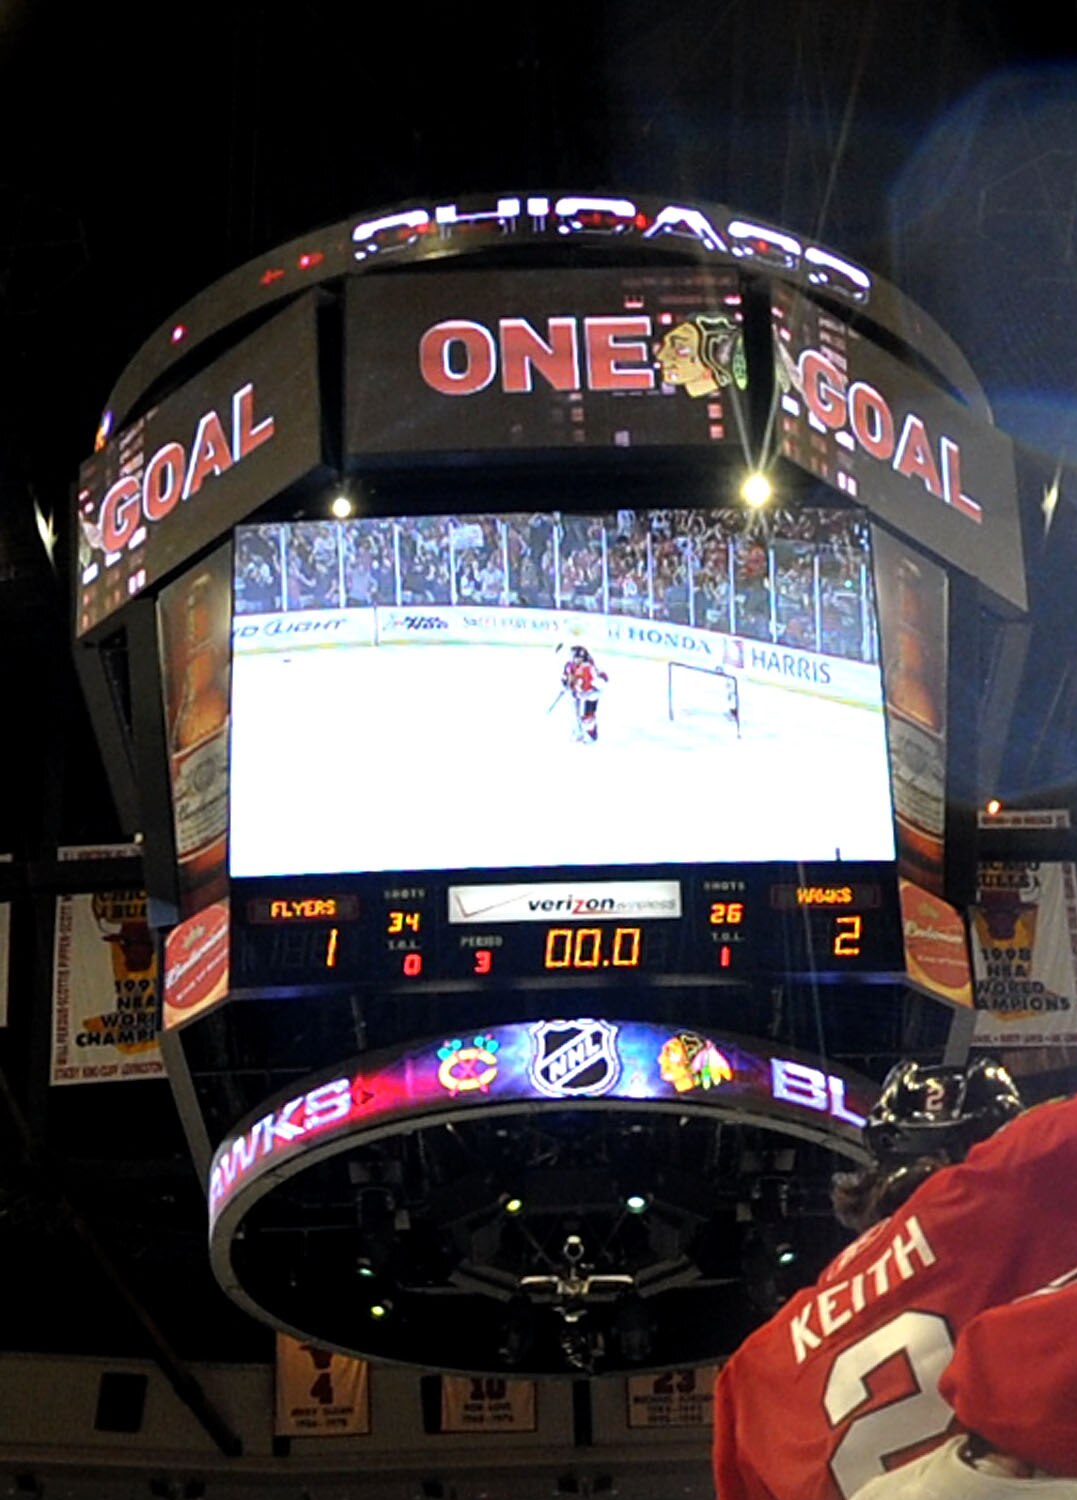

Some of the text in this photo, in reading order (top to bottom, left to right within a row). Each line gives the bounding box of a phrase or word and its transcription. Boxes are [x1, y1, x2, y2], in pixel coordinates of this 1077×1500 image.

[418, 316, 655, 396] ONE
[799, 348, 983, 523] GOAL
[100, 382, 275, 554] GOAL
[627, 625, 713, 656] HONDA
[750, 648, 832, 684] HARRIS
[270, 899, 337, 919] FLYERS
[528, 894, 615, 915] verizon
[709, 903, 743, 924] 26
[388, 912, 421, 934] 34
[833, 915, 862, 956] 2
[326, 928, 338, 967] 1
[474, 950, 492, 974] 3
[544, 927, 641, 969] 00.0
[719, 945, 731, 968] 1
[402, 953, 422, 976] 0
[546, 1034, 605, 1085] NHL
[923, 1083, 946, 1112] 2
[788, 1214, 937, 1364] KEITH
